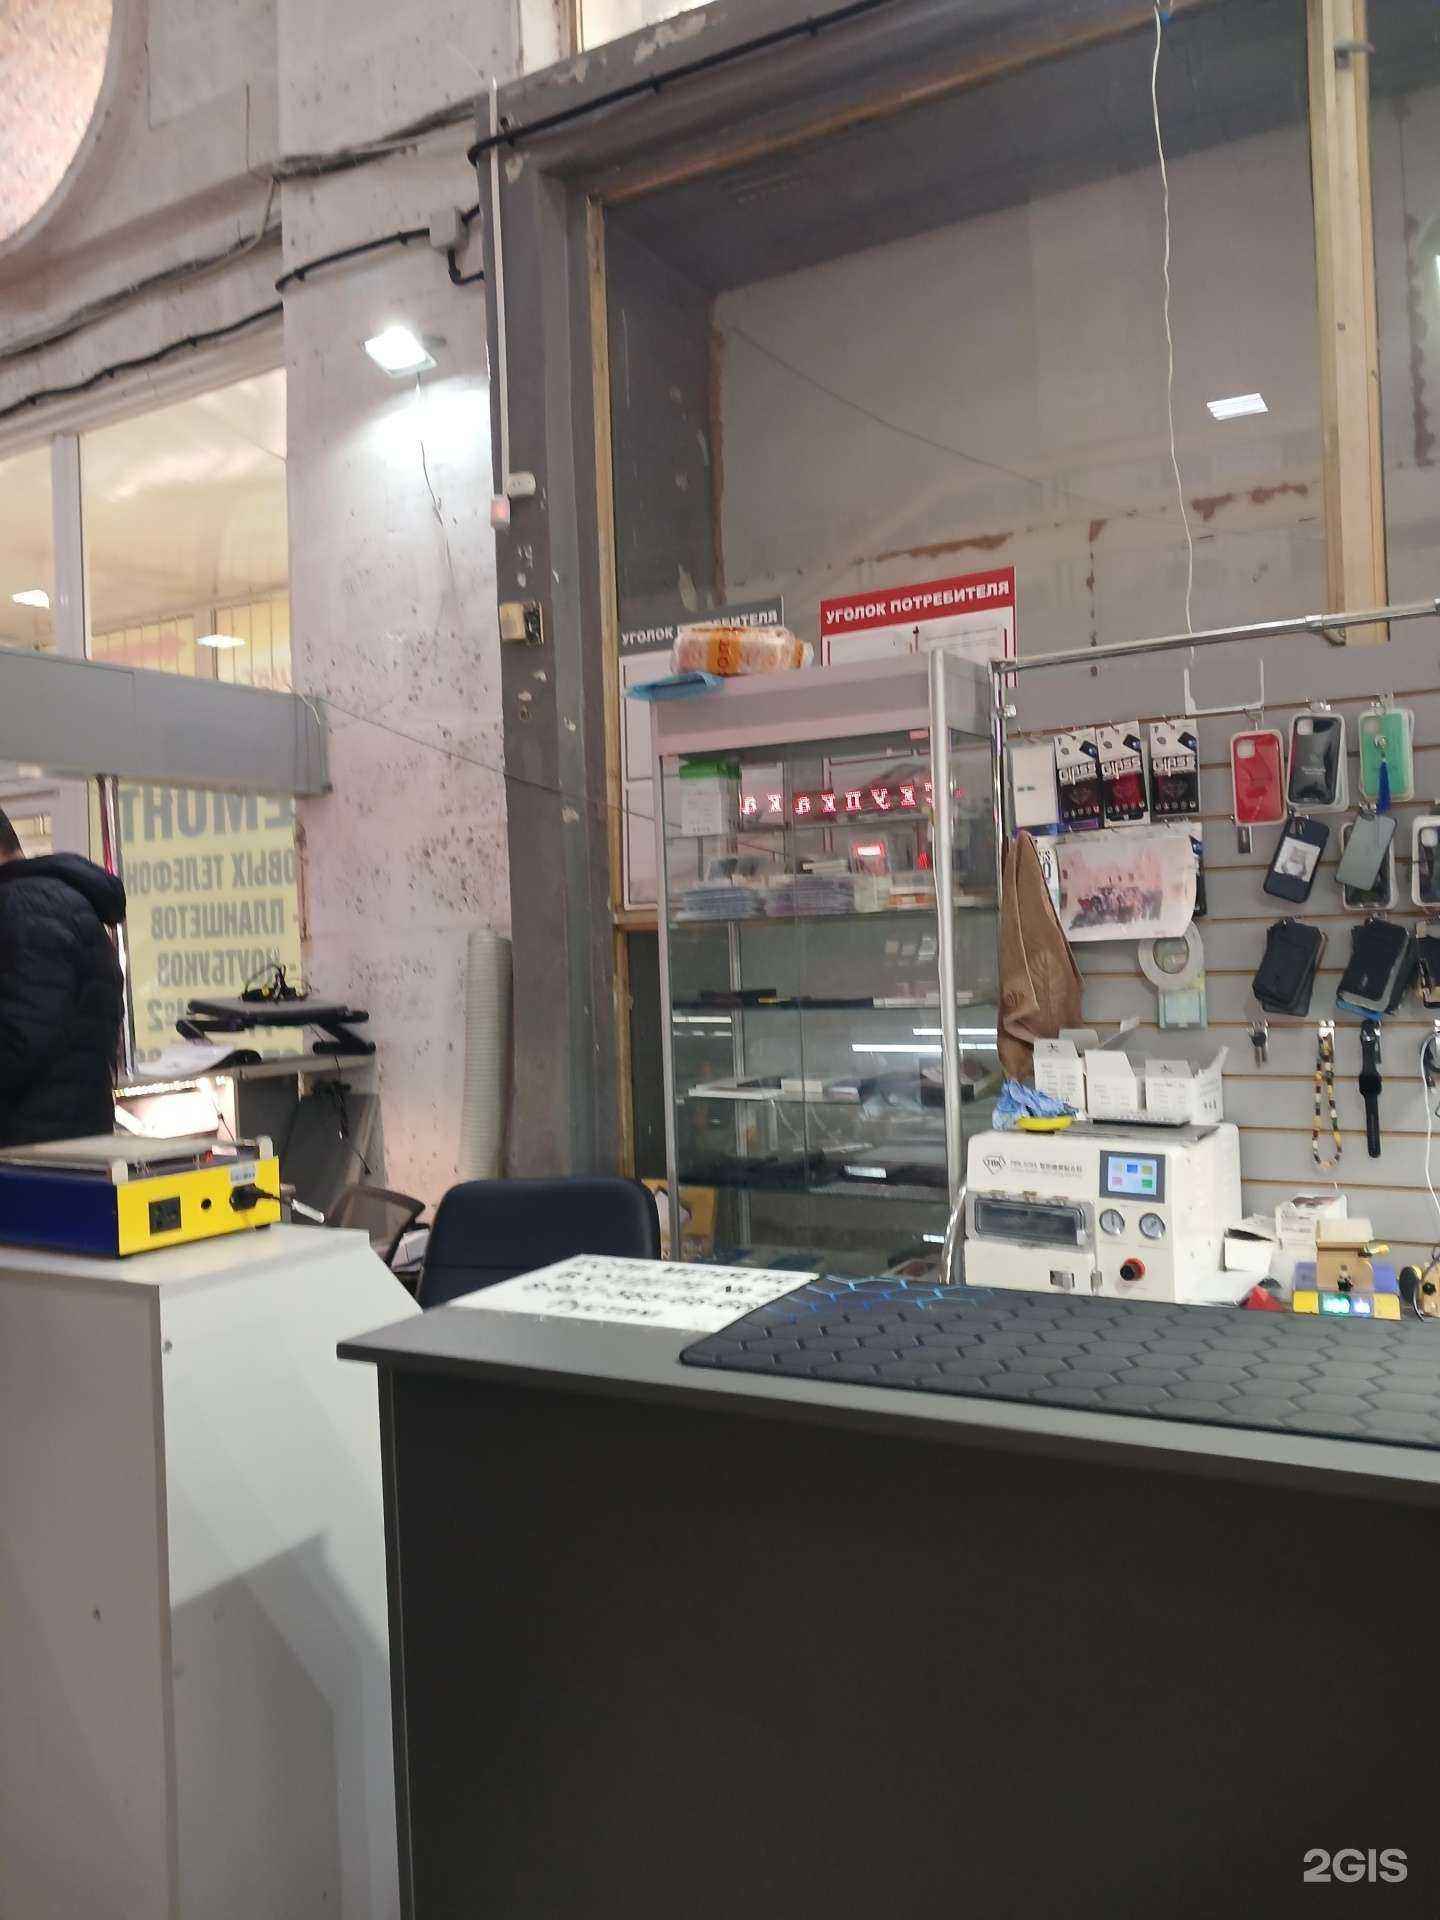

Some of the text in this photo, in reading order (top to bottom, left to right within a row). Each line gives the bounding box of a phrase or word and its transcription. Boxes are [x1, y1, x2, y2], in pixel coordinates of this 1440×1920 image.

[826, 580, 1010, 625] УГОЛОК ПОТРЕБИТЕЛЯ
[621, 625, 674, 647] УГОЛОК
